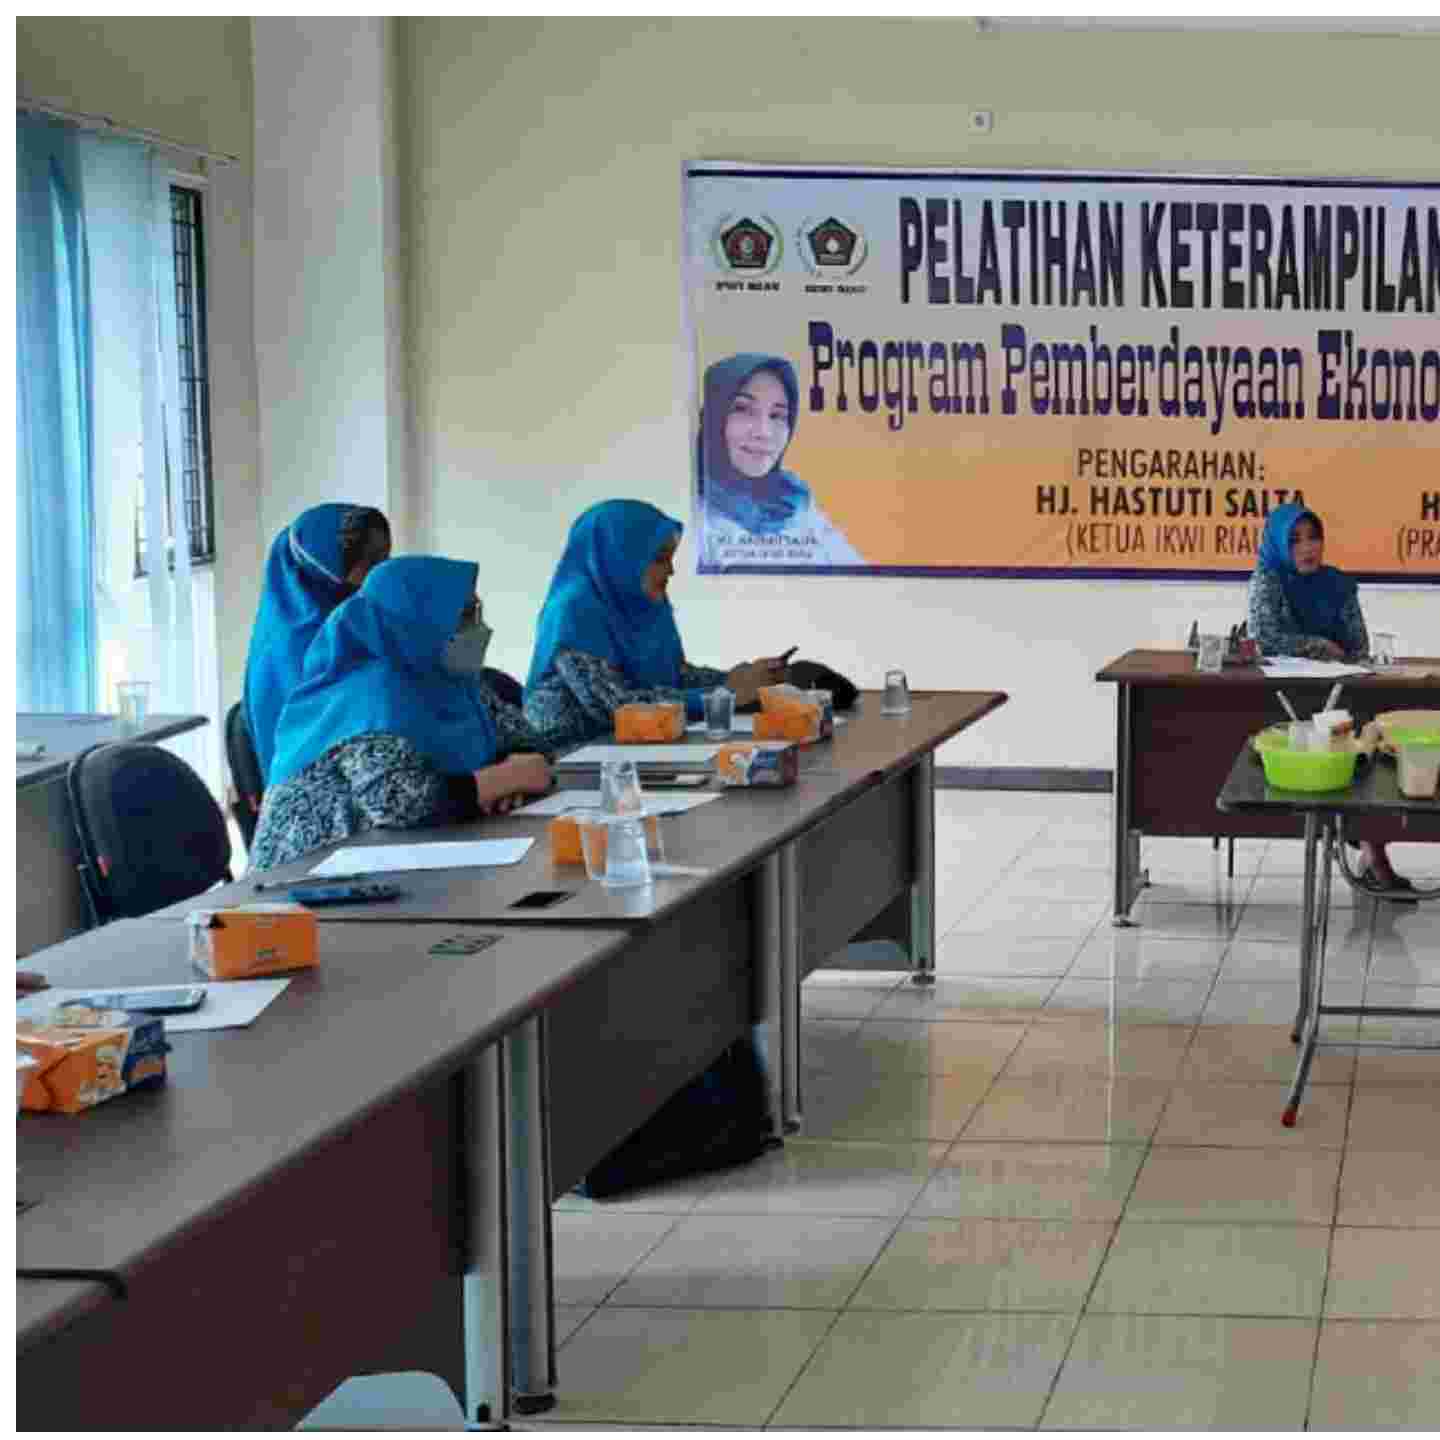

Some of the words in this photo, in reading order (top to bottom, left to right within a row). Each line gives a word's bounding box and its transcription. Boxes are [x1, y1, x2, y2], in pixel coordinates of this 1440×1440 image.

[899, 197, 1125, 308] PELATIHAN
[808, 320, 990, 432] Program
[1001, 323, 1305, 436] Pemberdayaan
[1077, 448, 1265, 481] PENGARAHAN:
[1036, 484, 1079, 515] HJ.
[1090, 485, 1213, 518] HASTUTI
[1066, 522, 1145, 560] (KETUA
[1155, 524, 1205, 555] IKWI
